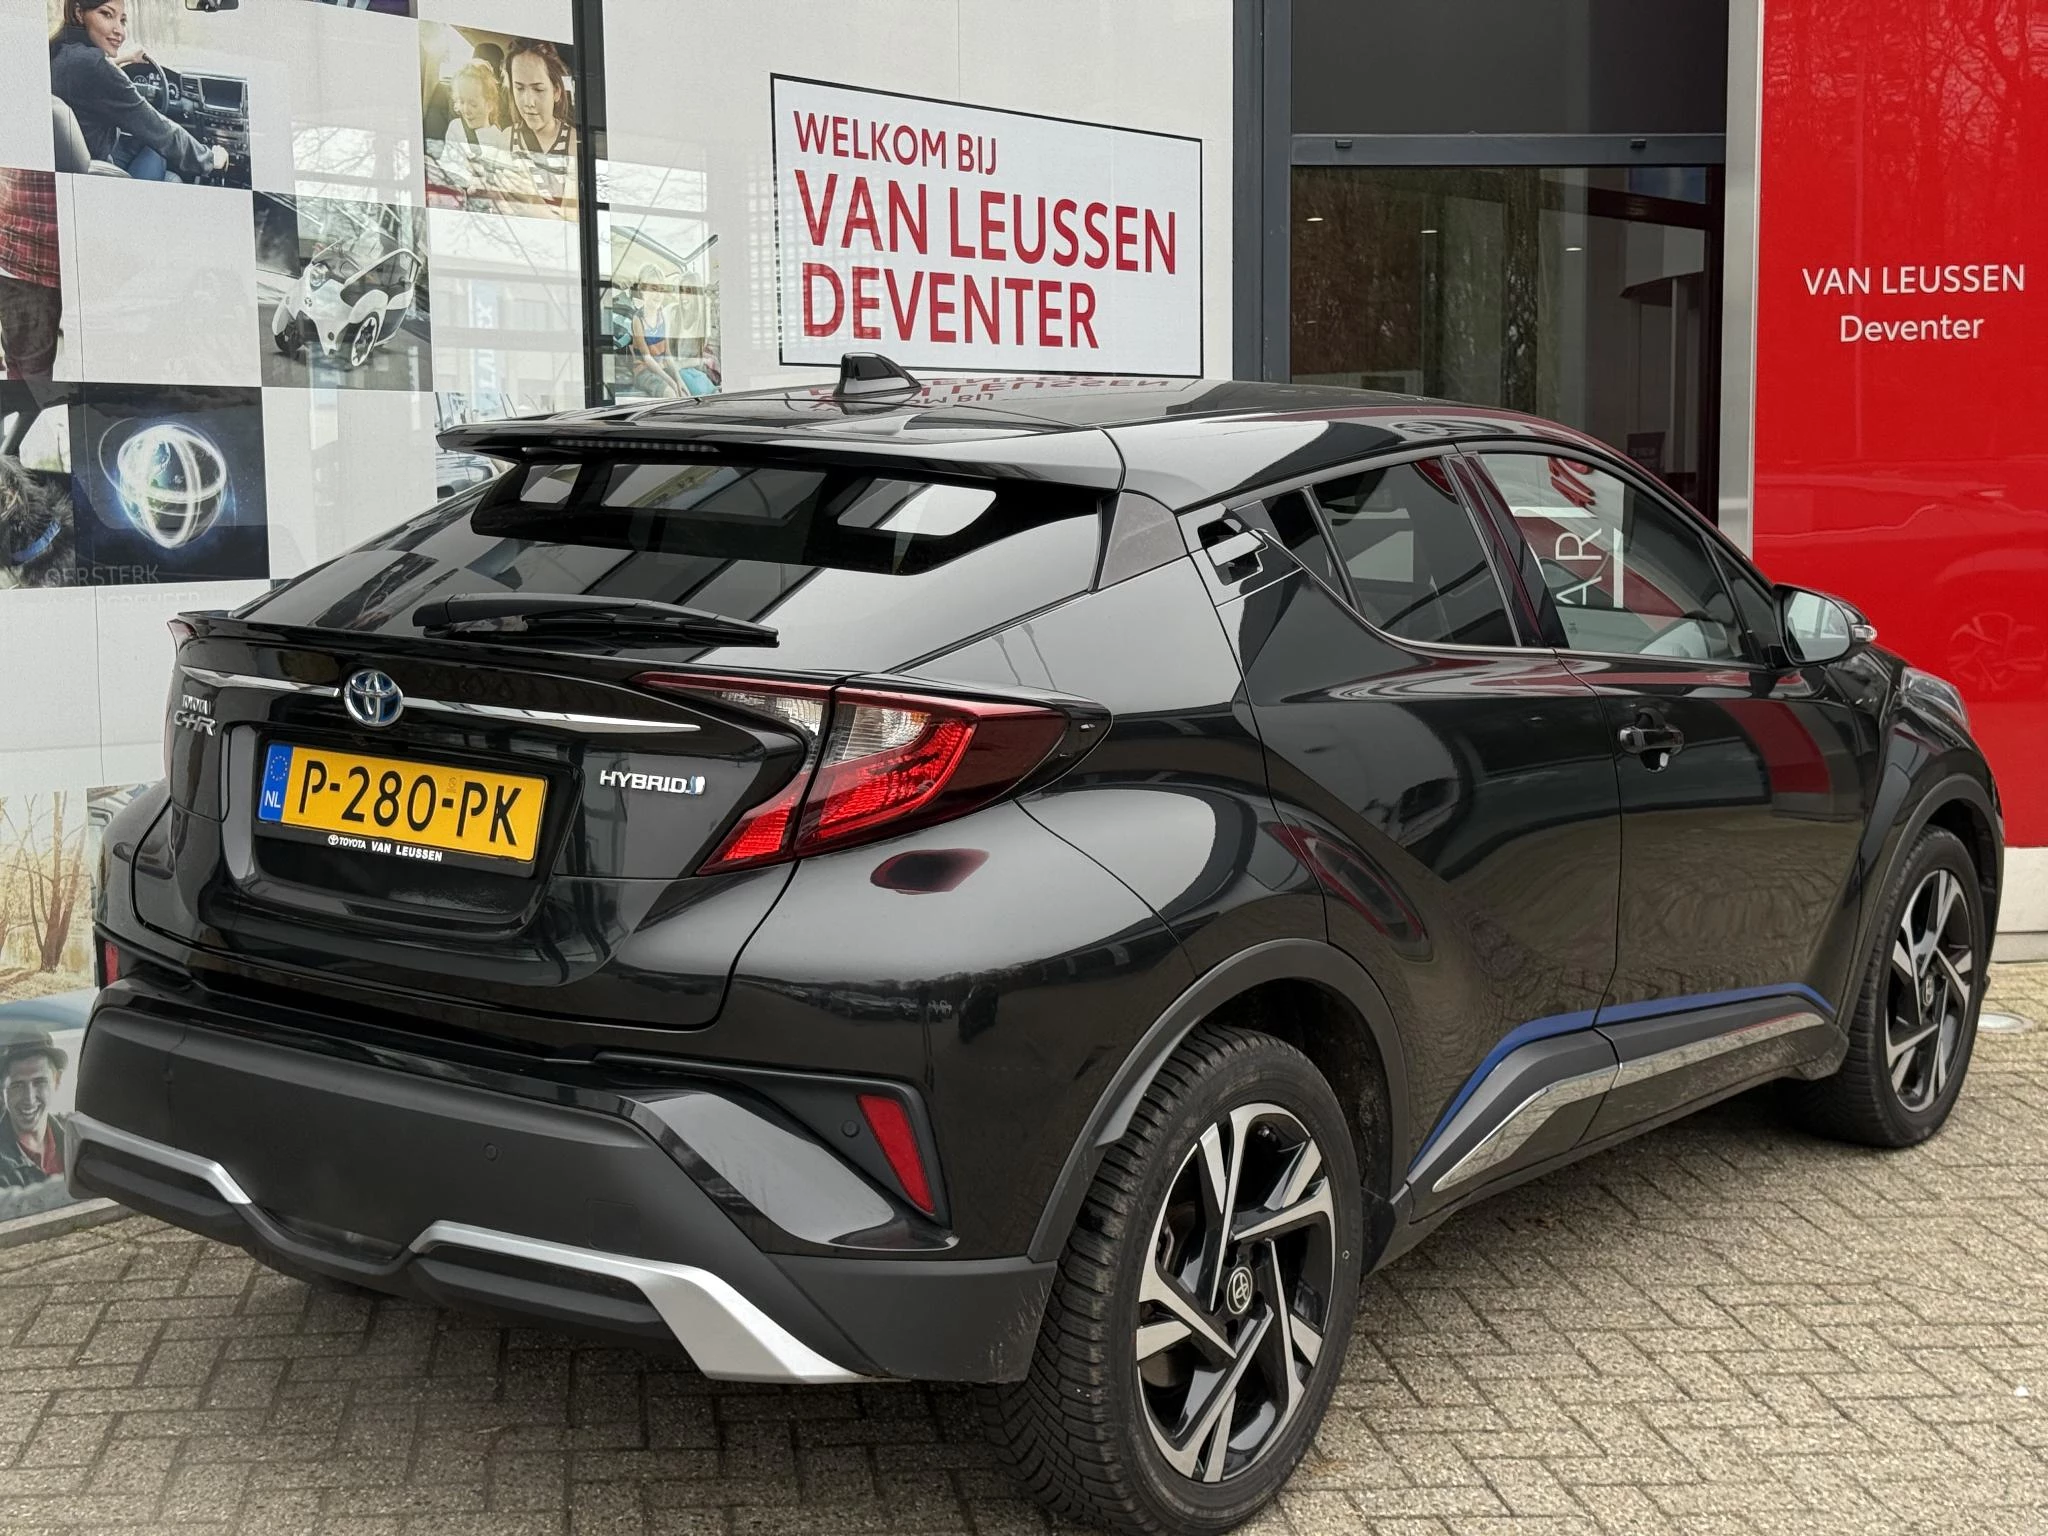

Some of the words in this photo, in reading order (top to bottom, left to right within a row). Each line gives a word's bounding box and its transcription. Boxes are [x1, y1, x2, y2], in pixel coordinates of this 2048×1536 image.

[793, 110, 947, 169] WELKOM
[957, 133, 997, 175] BIJ
[794, 169, 928, 255] VAN
[949, 186, 1176, 275] LEUSSEN
[1802, 267, 1871, 295] VAN
[1882, 264, 2025, 294] LEUSSEN
[802, 261, 1100, 349] DEVENTER
[1840, 314, 1984, 342] Deventer
[600, 769, 688, 794] HYBRID
[264, 790, 281, 808] NL
[298, 759, 522, 846] P-280-PK
[339, 836, 367, 850] TOYOTA
[371, 841, 392, 854] VAN
[395, 845, 443, 862] LEUSSEN
